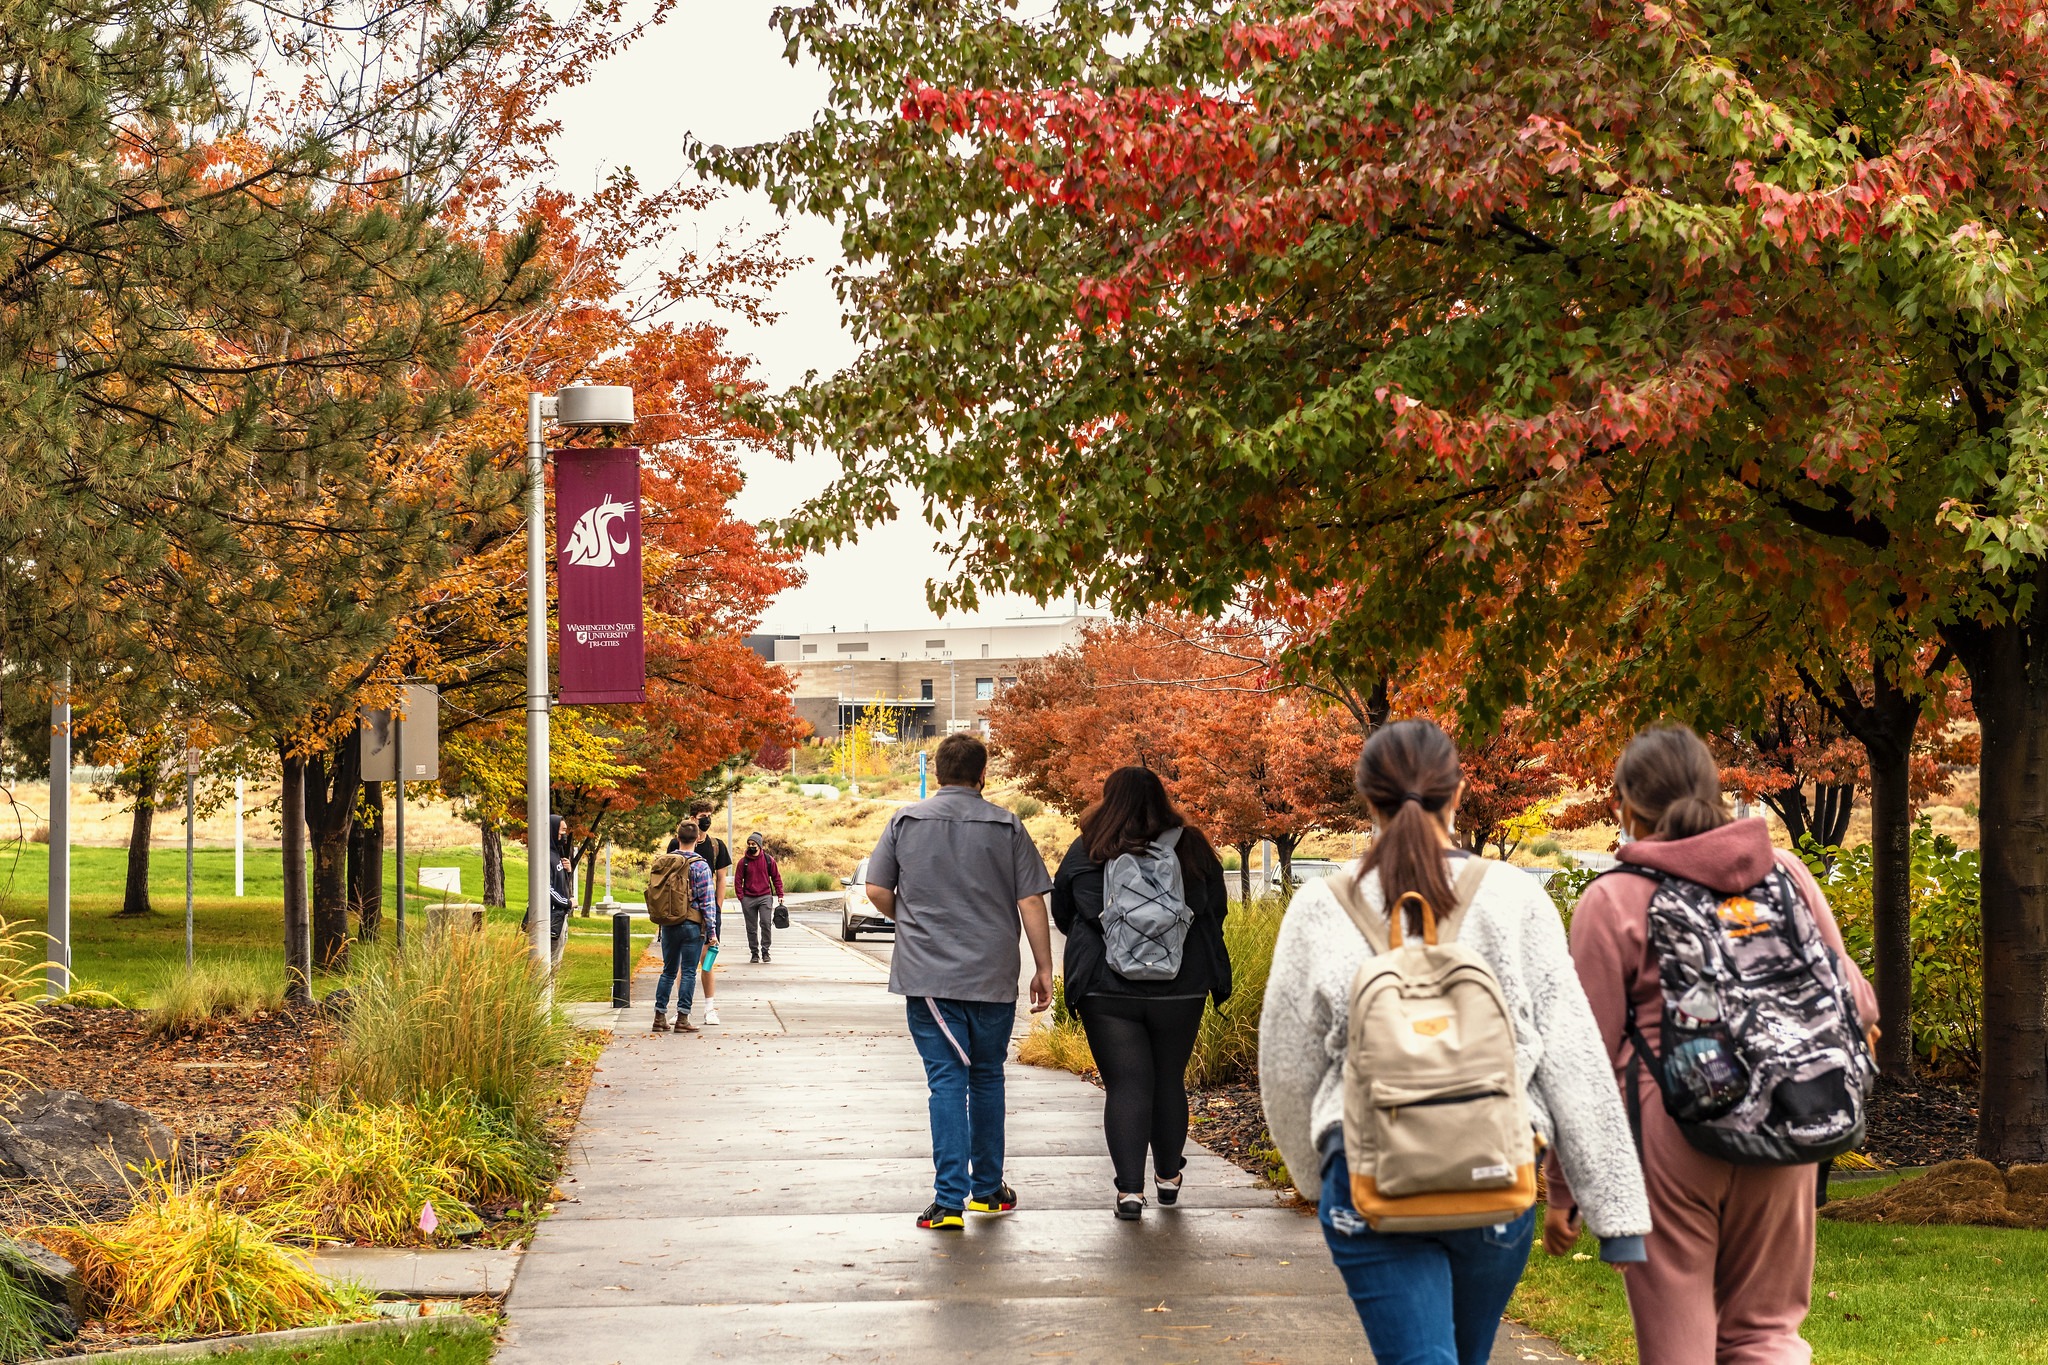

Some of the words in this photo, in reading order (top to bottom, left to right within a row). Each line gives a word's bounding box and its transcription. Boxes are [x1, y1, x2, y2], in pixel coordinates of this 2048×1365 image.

[567, 624, 615, 632] WASHINGTON
[616, 623, 635, 631] STATE
[588, 632, 628, 640] UNIVERSITY
